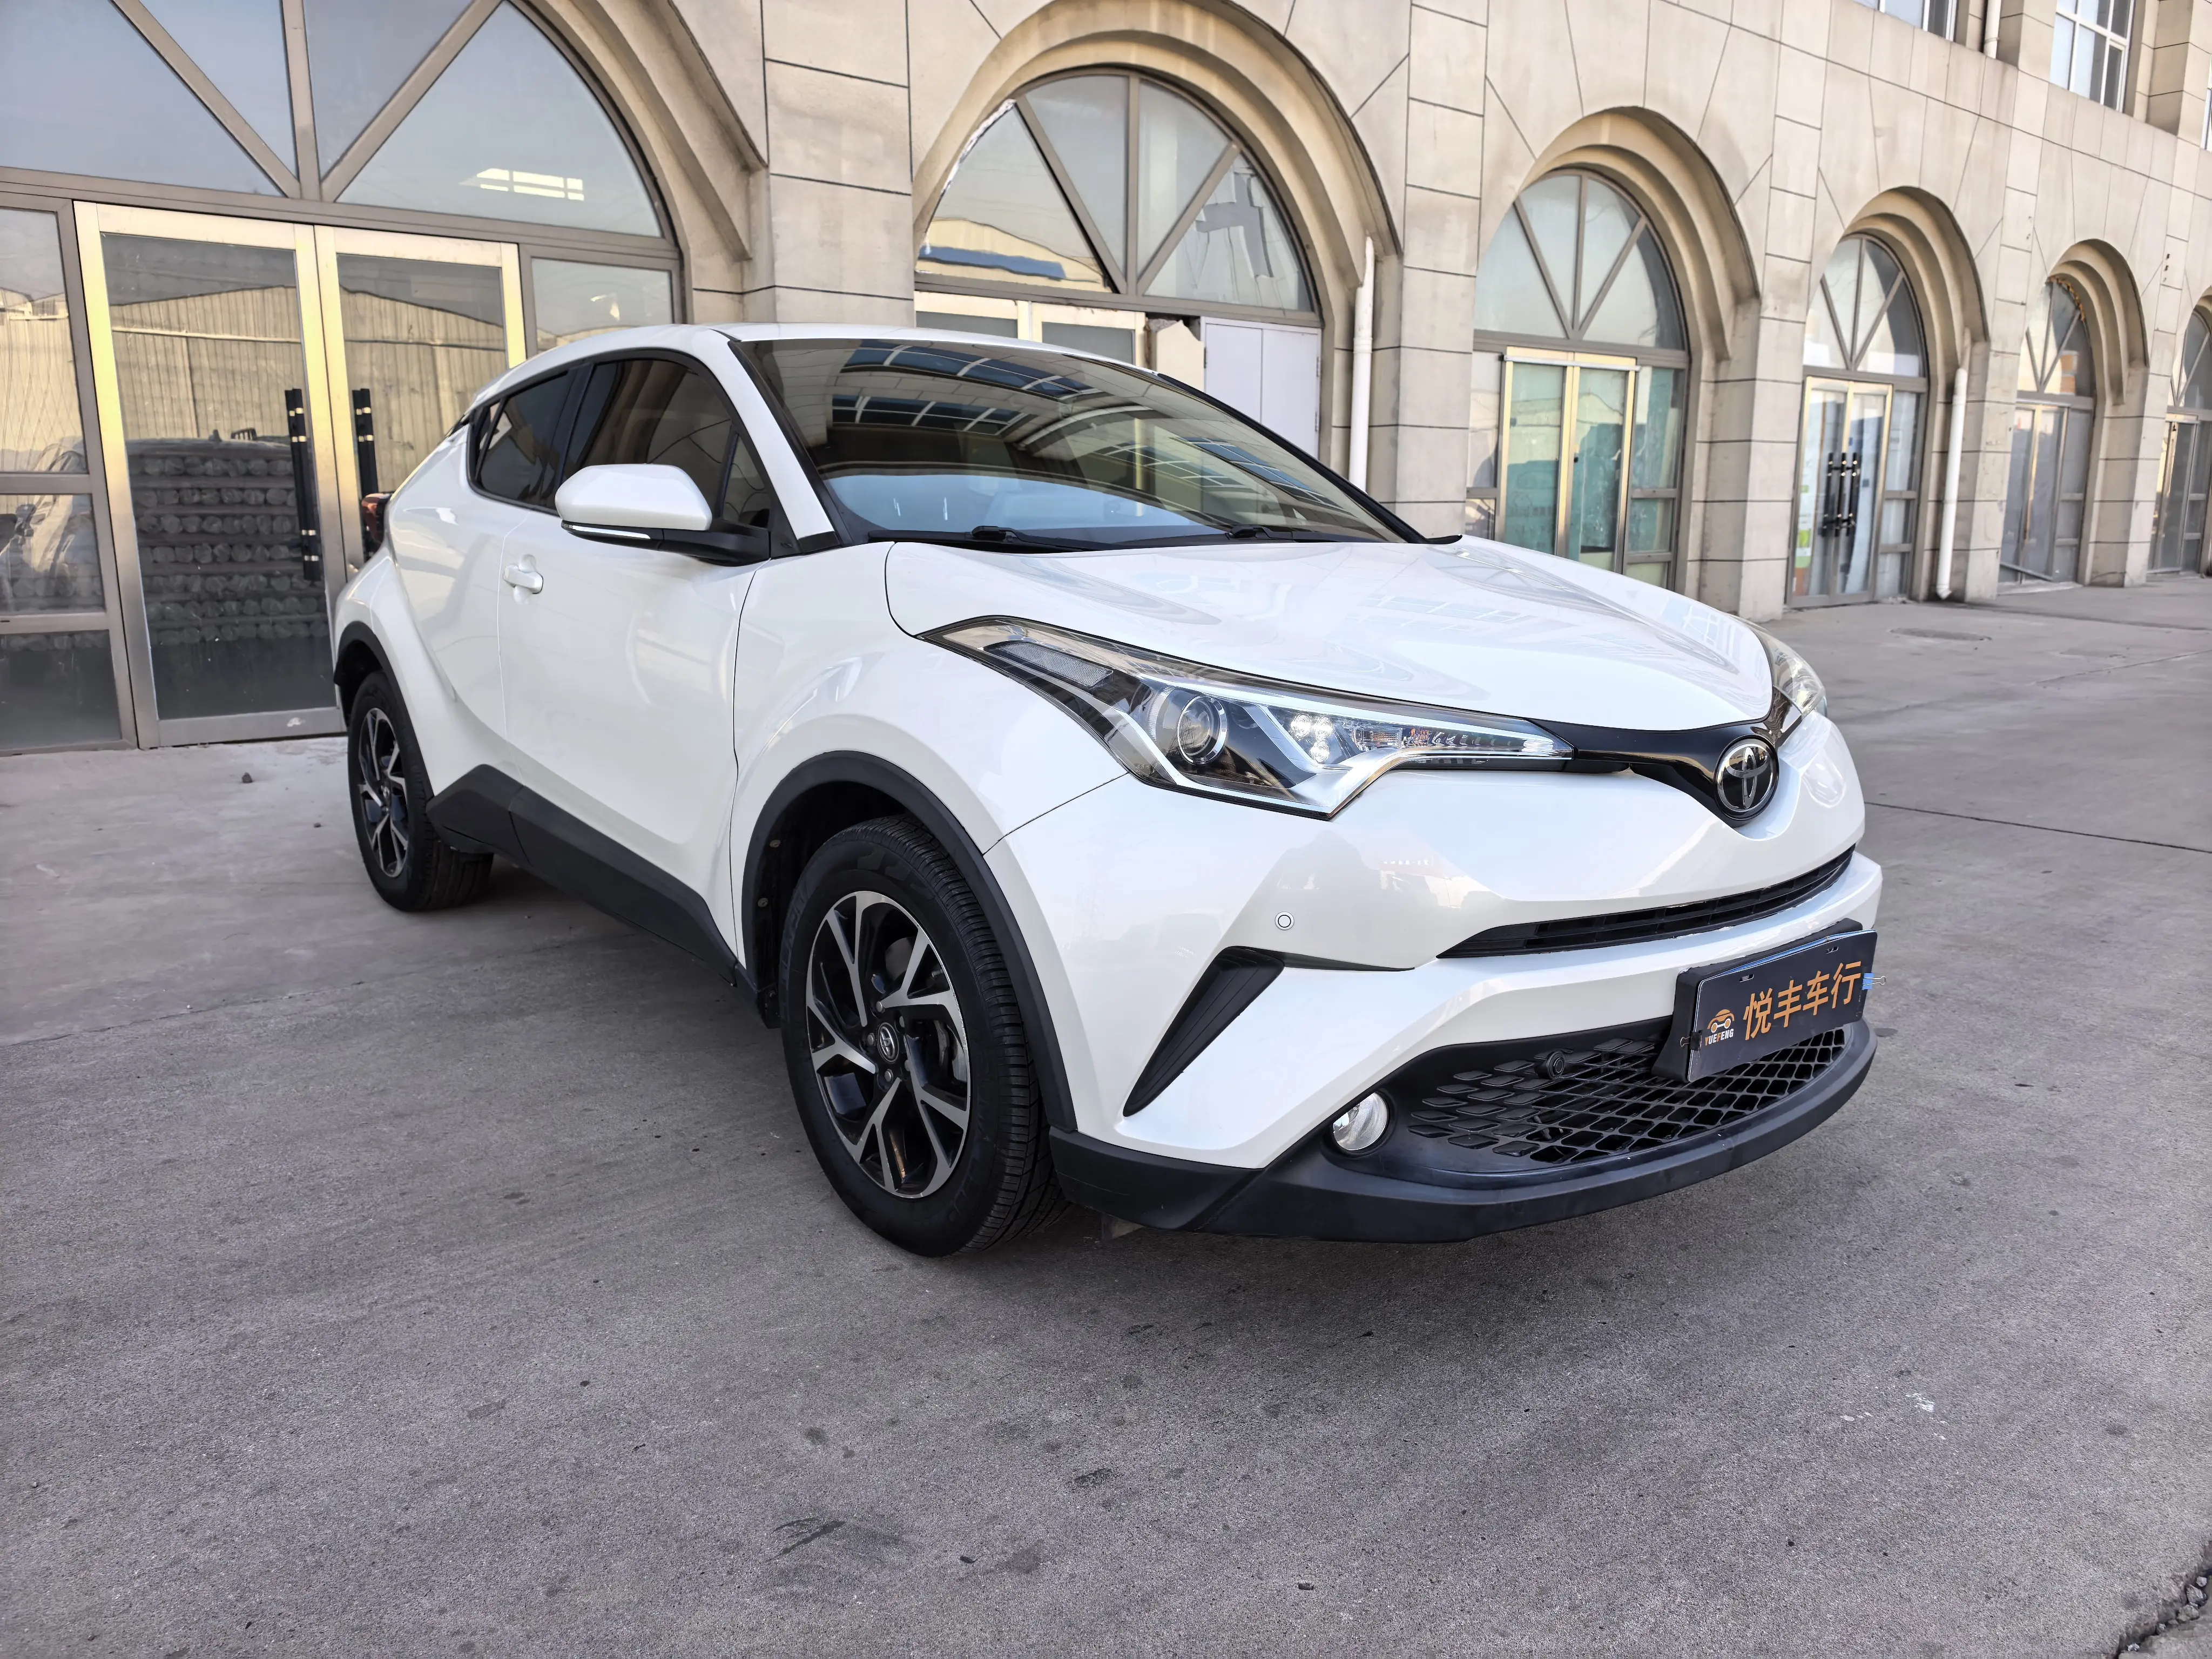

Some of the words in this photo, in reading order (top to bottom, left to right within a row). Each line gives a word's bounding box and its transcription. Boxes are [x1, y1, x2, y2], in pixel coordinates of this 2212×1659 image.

[1743, 961, 1862, 1040] 悦丰车行
[1705, 1029, 1734, 1046] YUEFENG
